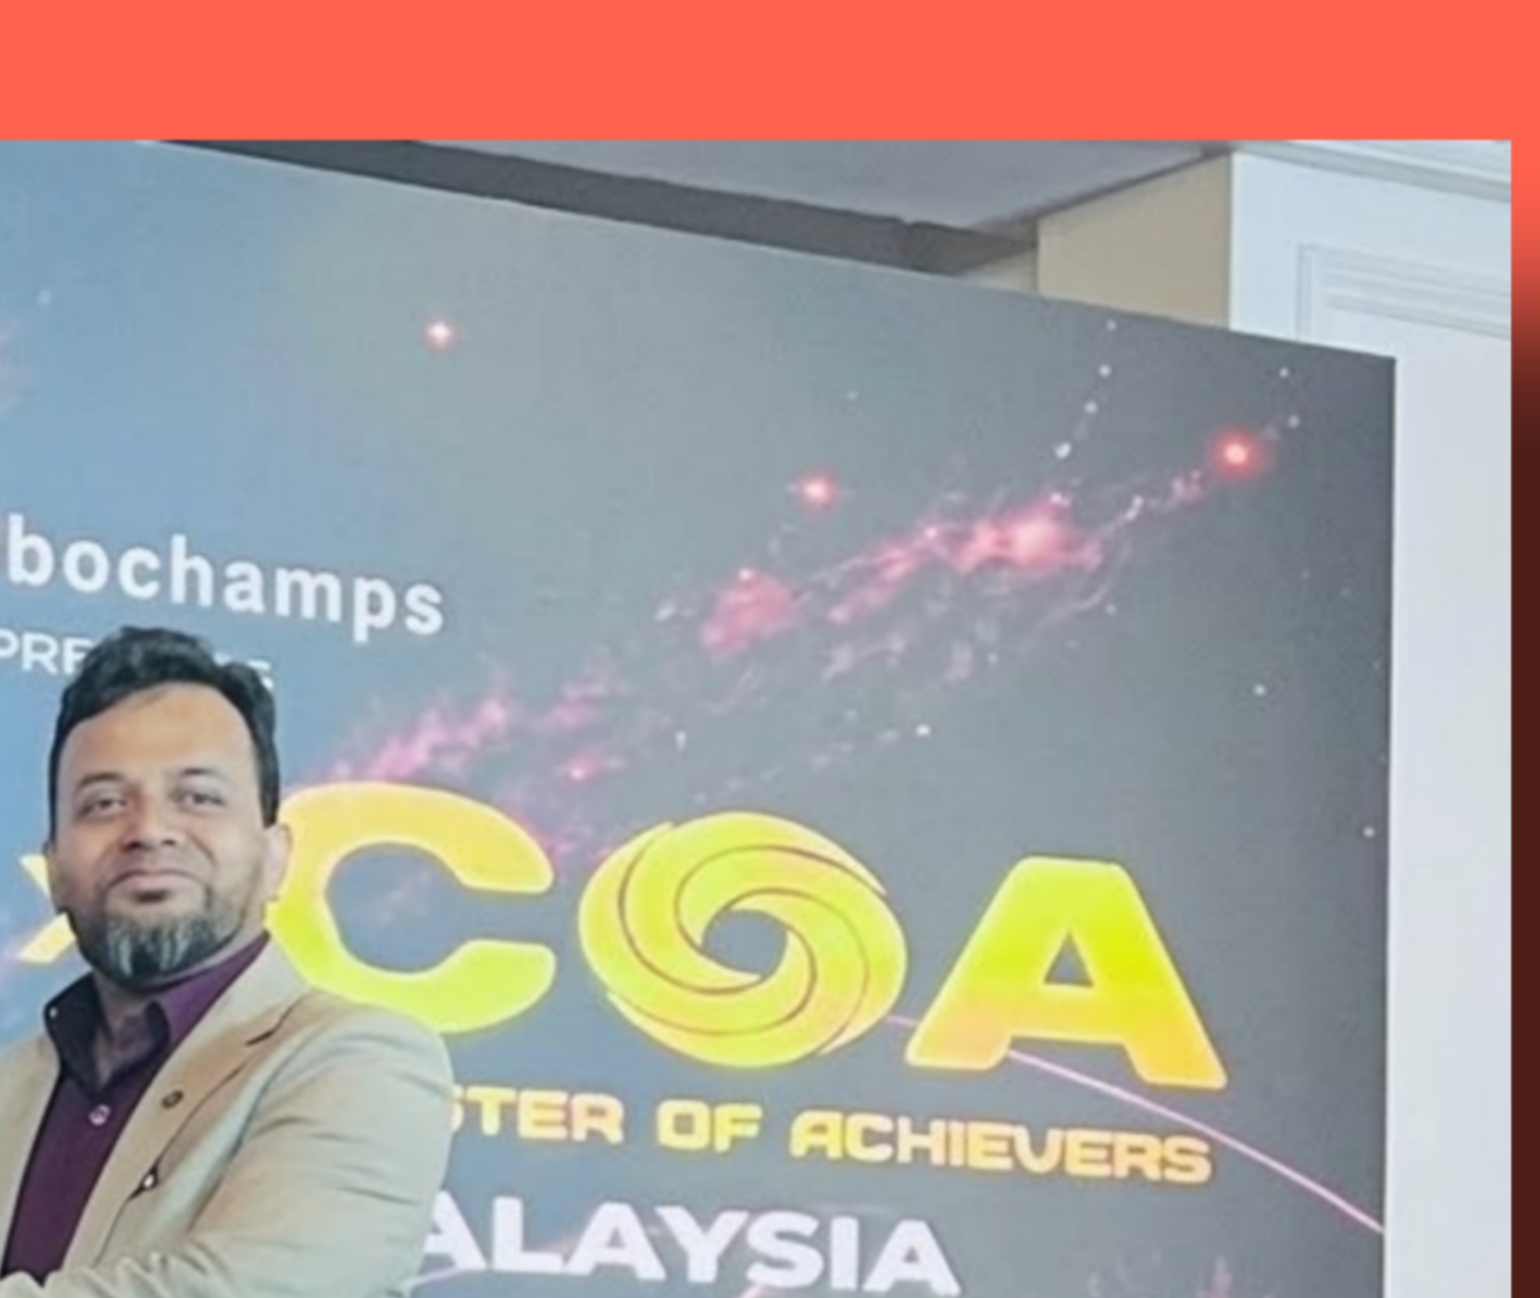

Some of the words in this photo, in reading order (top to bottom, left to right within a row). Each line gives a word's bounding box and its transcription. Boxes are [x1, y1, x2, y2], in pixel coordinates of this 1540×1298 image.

[266, 780, 1229, 1090] COA
[657, 1099, 763, 1153] OF
[789, 1109, 1213, 1183] ACHIEVERS
[423, 1188, 962, 1298] ALAYSIA
